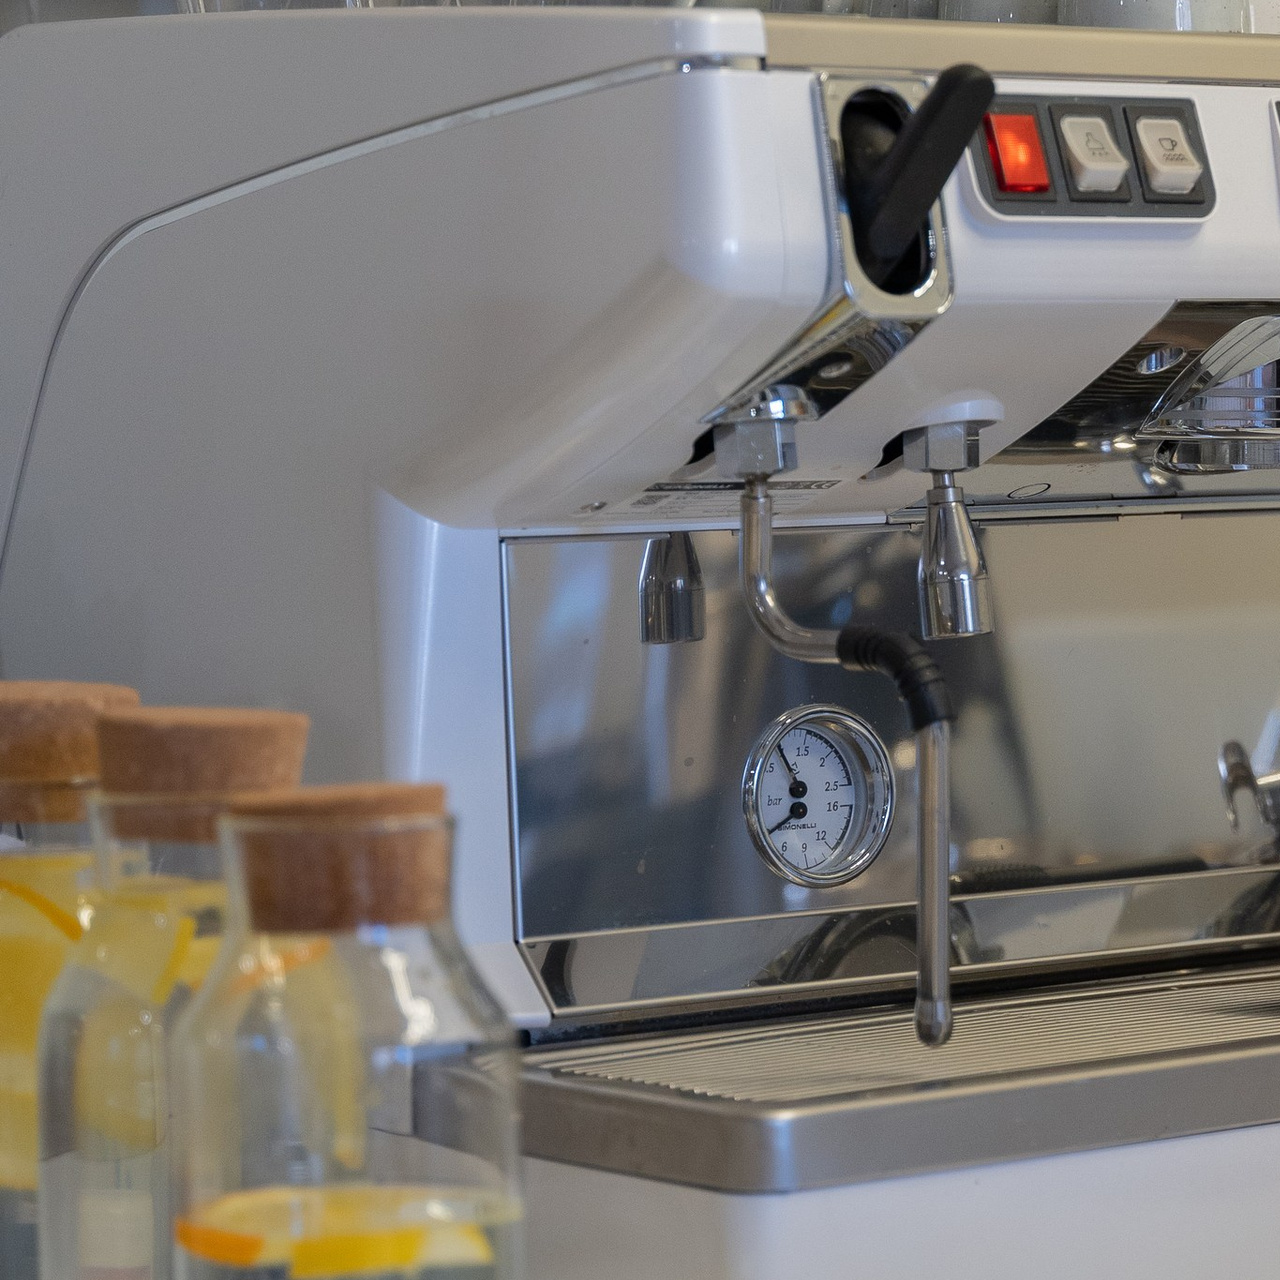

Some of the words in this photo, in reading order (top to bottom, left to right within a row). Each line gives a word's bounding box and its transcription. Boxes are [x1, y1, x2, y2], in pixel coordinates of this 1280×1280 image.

[796, 746, 809, 757] 1.5
[819, 757, 826, 767] 2
[825, 781, 838, 791] 2.5
[767, 795, 782, 806] bar
[827, 801, 838, 812] 16
[816, 830, 827, 841] 12
[781, 842, 787, 852] 6
[802, 843, 807, 853] 9
